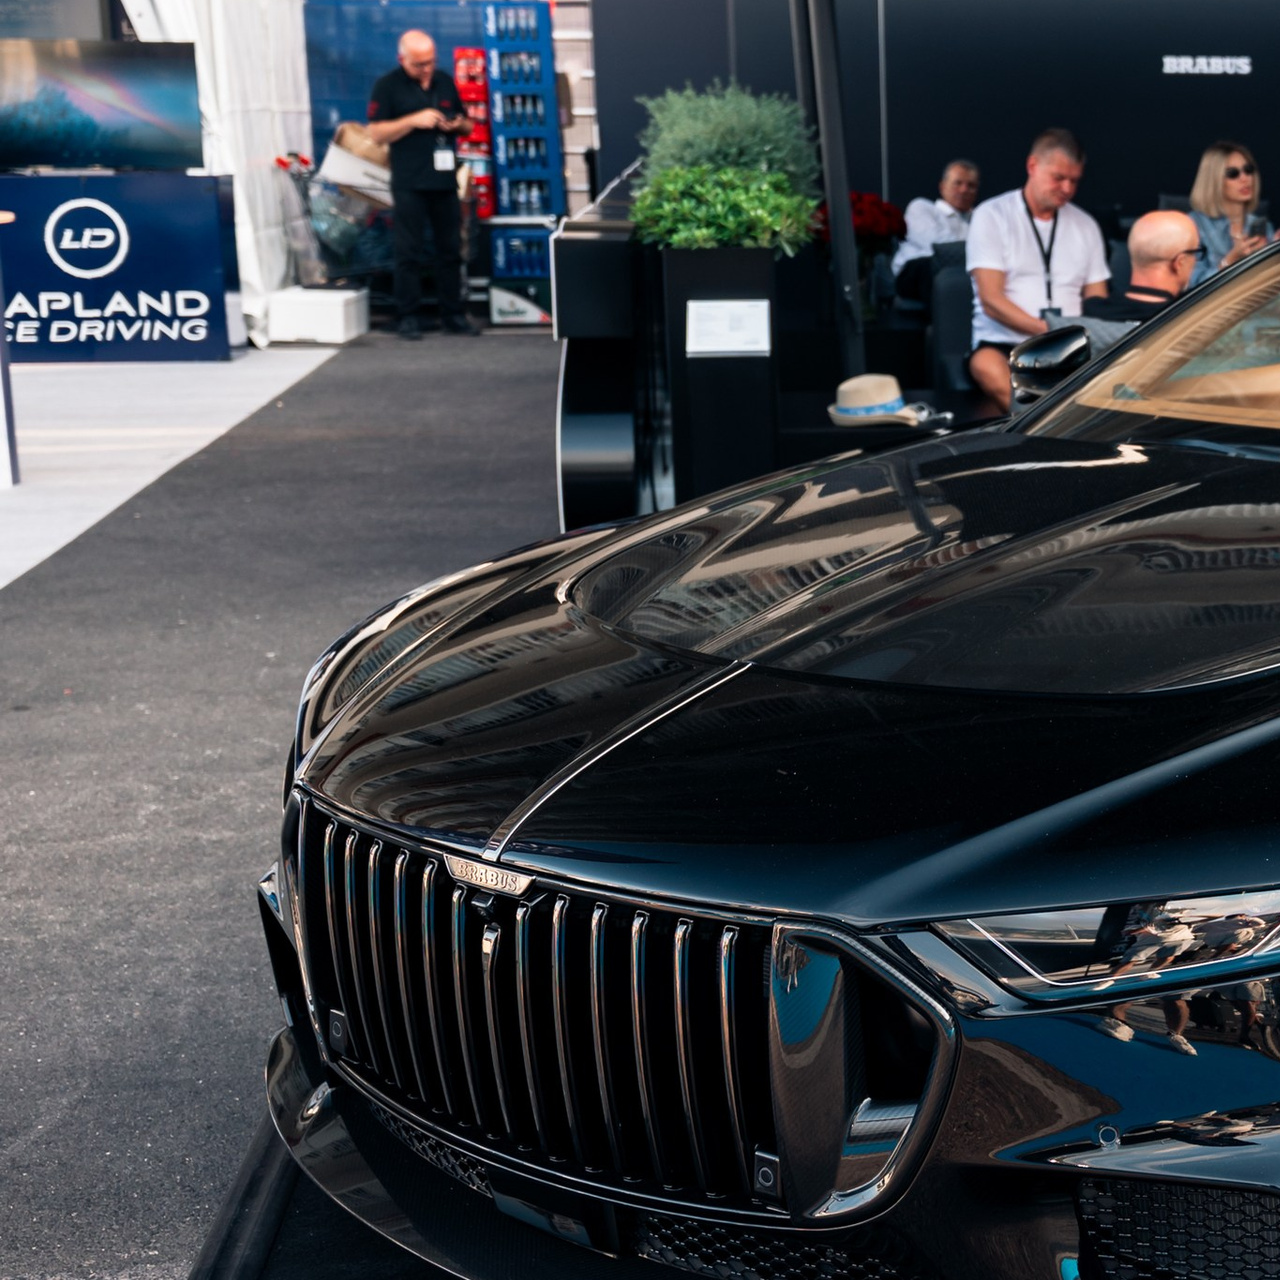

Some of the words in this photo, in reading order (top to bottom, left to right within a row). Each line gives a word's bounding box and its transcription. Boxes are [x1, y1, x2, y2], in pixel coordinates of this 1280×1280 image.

[1162, 55, 1252, 74] BRABUS
[49, 319, 208, 342] DRIVING
[458, 863, 518, 891] BRABUS
